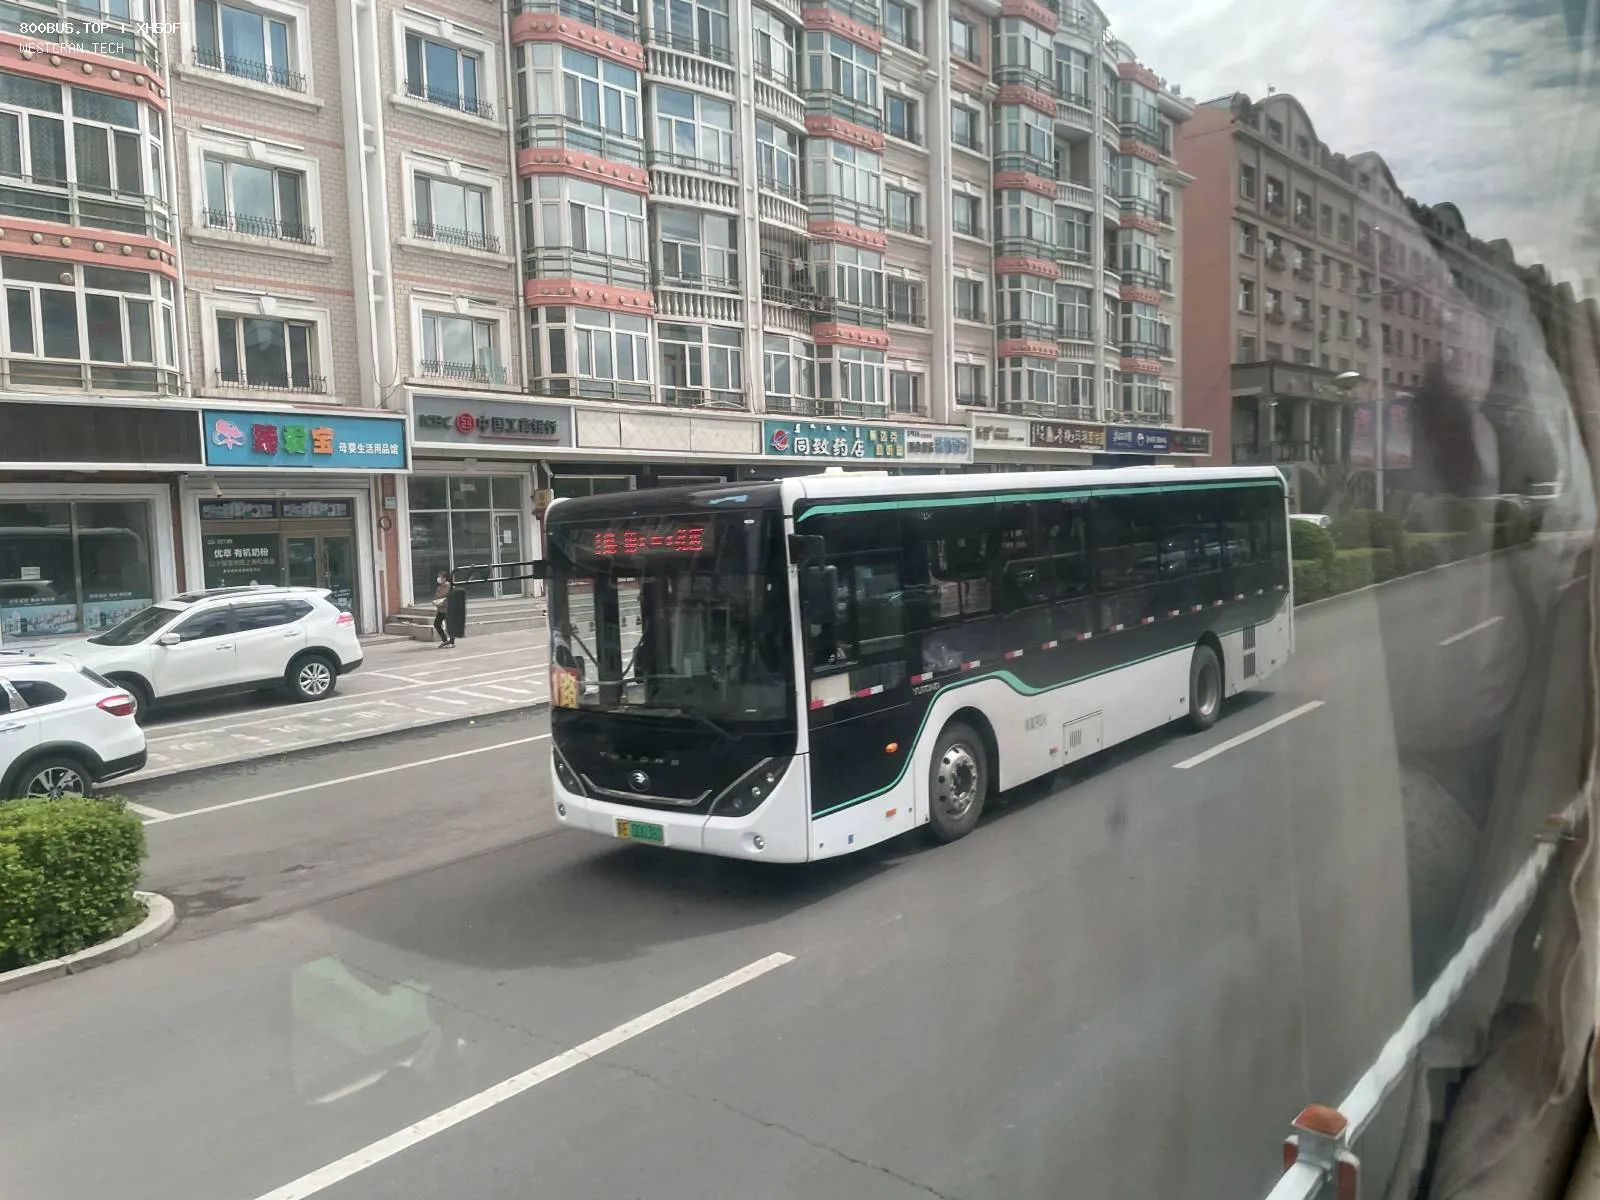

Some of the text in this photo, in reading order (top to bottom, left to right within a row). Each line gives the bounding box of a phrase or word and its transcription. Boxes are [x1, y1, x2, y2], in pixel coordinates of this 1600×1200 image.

[477, 415, 557, 435] 中国工商银行
[338, 442, 399, 455] 母婴生活用品馆
[794, 437, 864, 457] 同致药店
[234, 547, 269, 558] 有机奶粉
[911, 682, 940, 697] YUTONG
